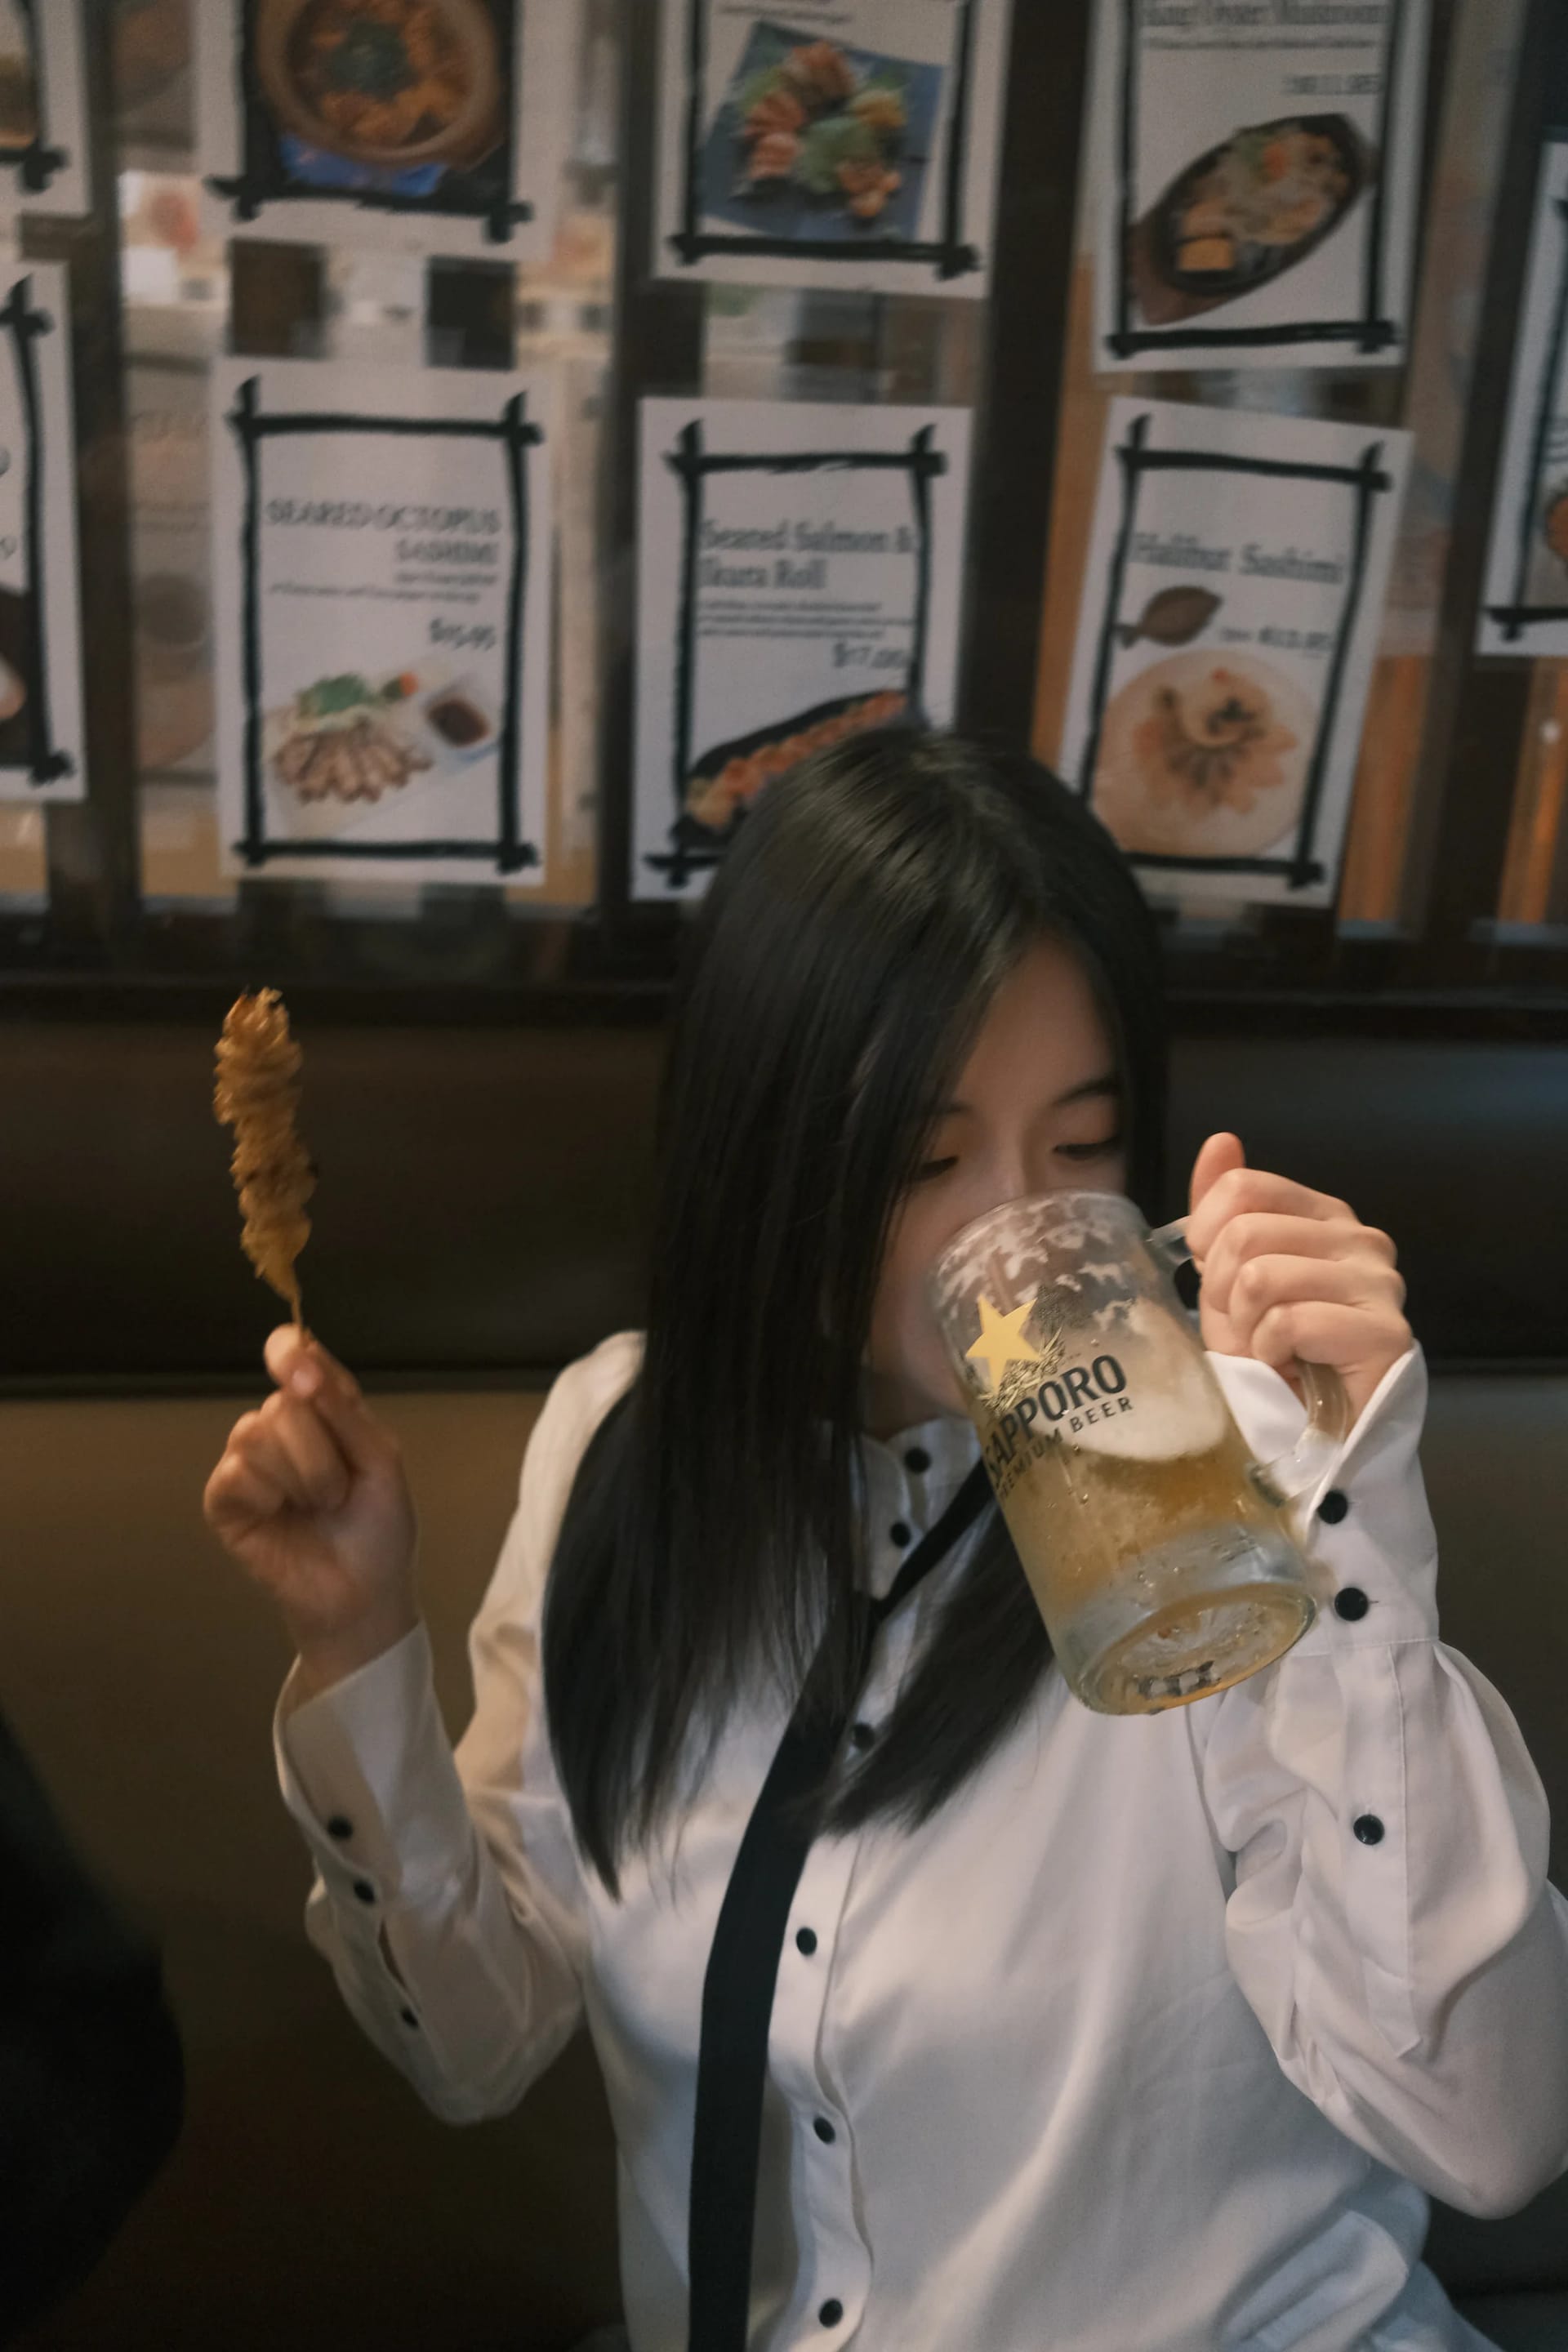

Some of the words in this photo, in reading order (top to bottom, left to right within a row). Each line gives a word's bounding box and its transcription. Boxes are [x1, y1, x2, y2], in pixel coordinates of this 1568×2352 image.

[266, 498, 370, 528] SEARED
[372, 502, 502, 535] OCTOPUS
[697, 517, 790, 551] Seared
[795, 519, 889, 553] Salmon
[774, 559, 827, 590] Roll
[1238, 542, 1346, 586] Sashimi
[984, 1353, 1127, 1490] SAPPORO
[1069, 1396, 1134, 1433] BEER
